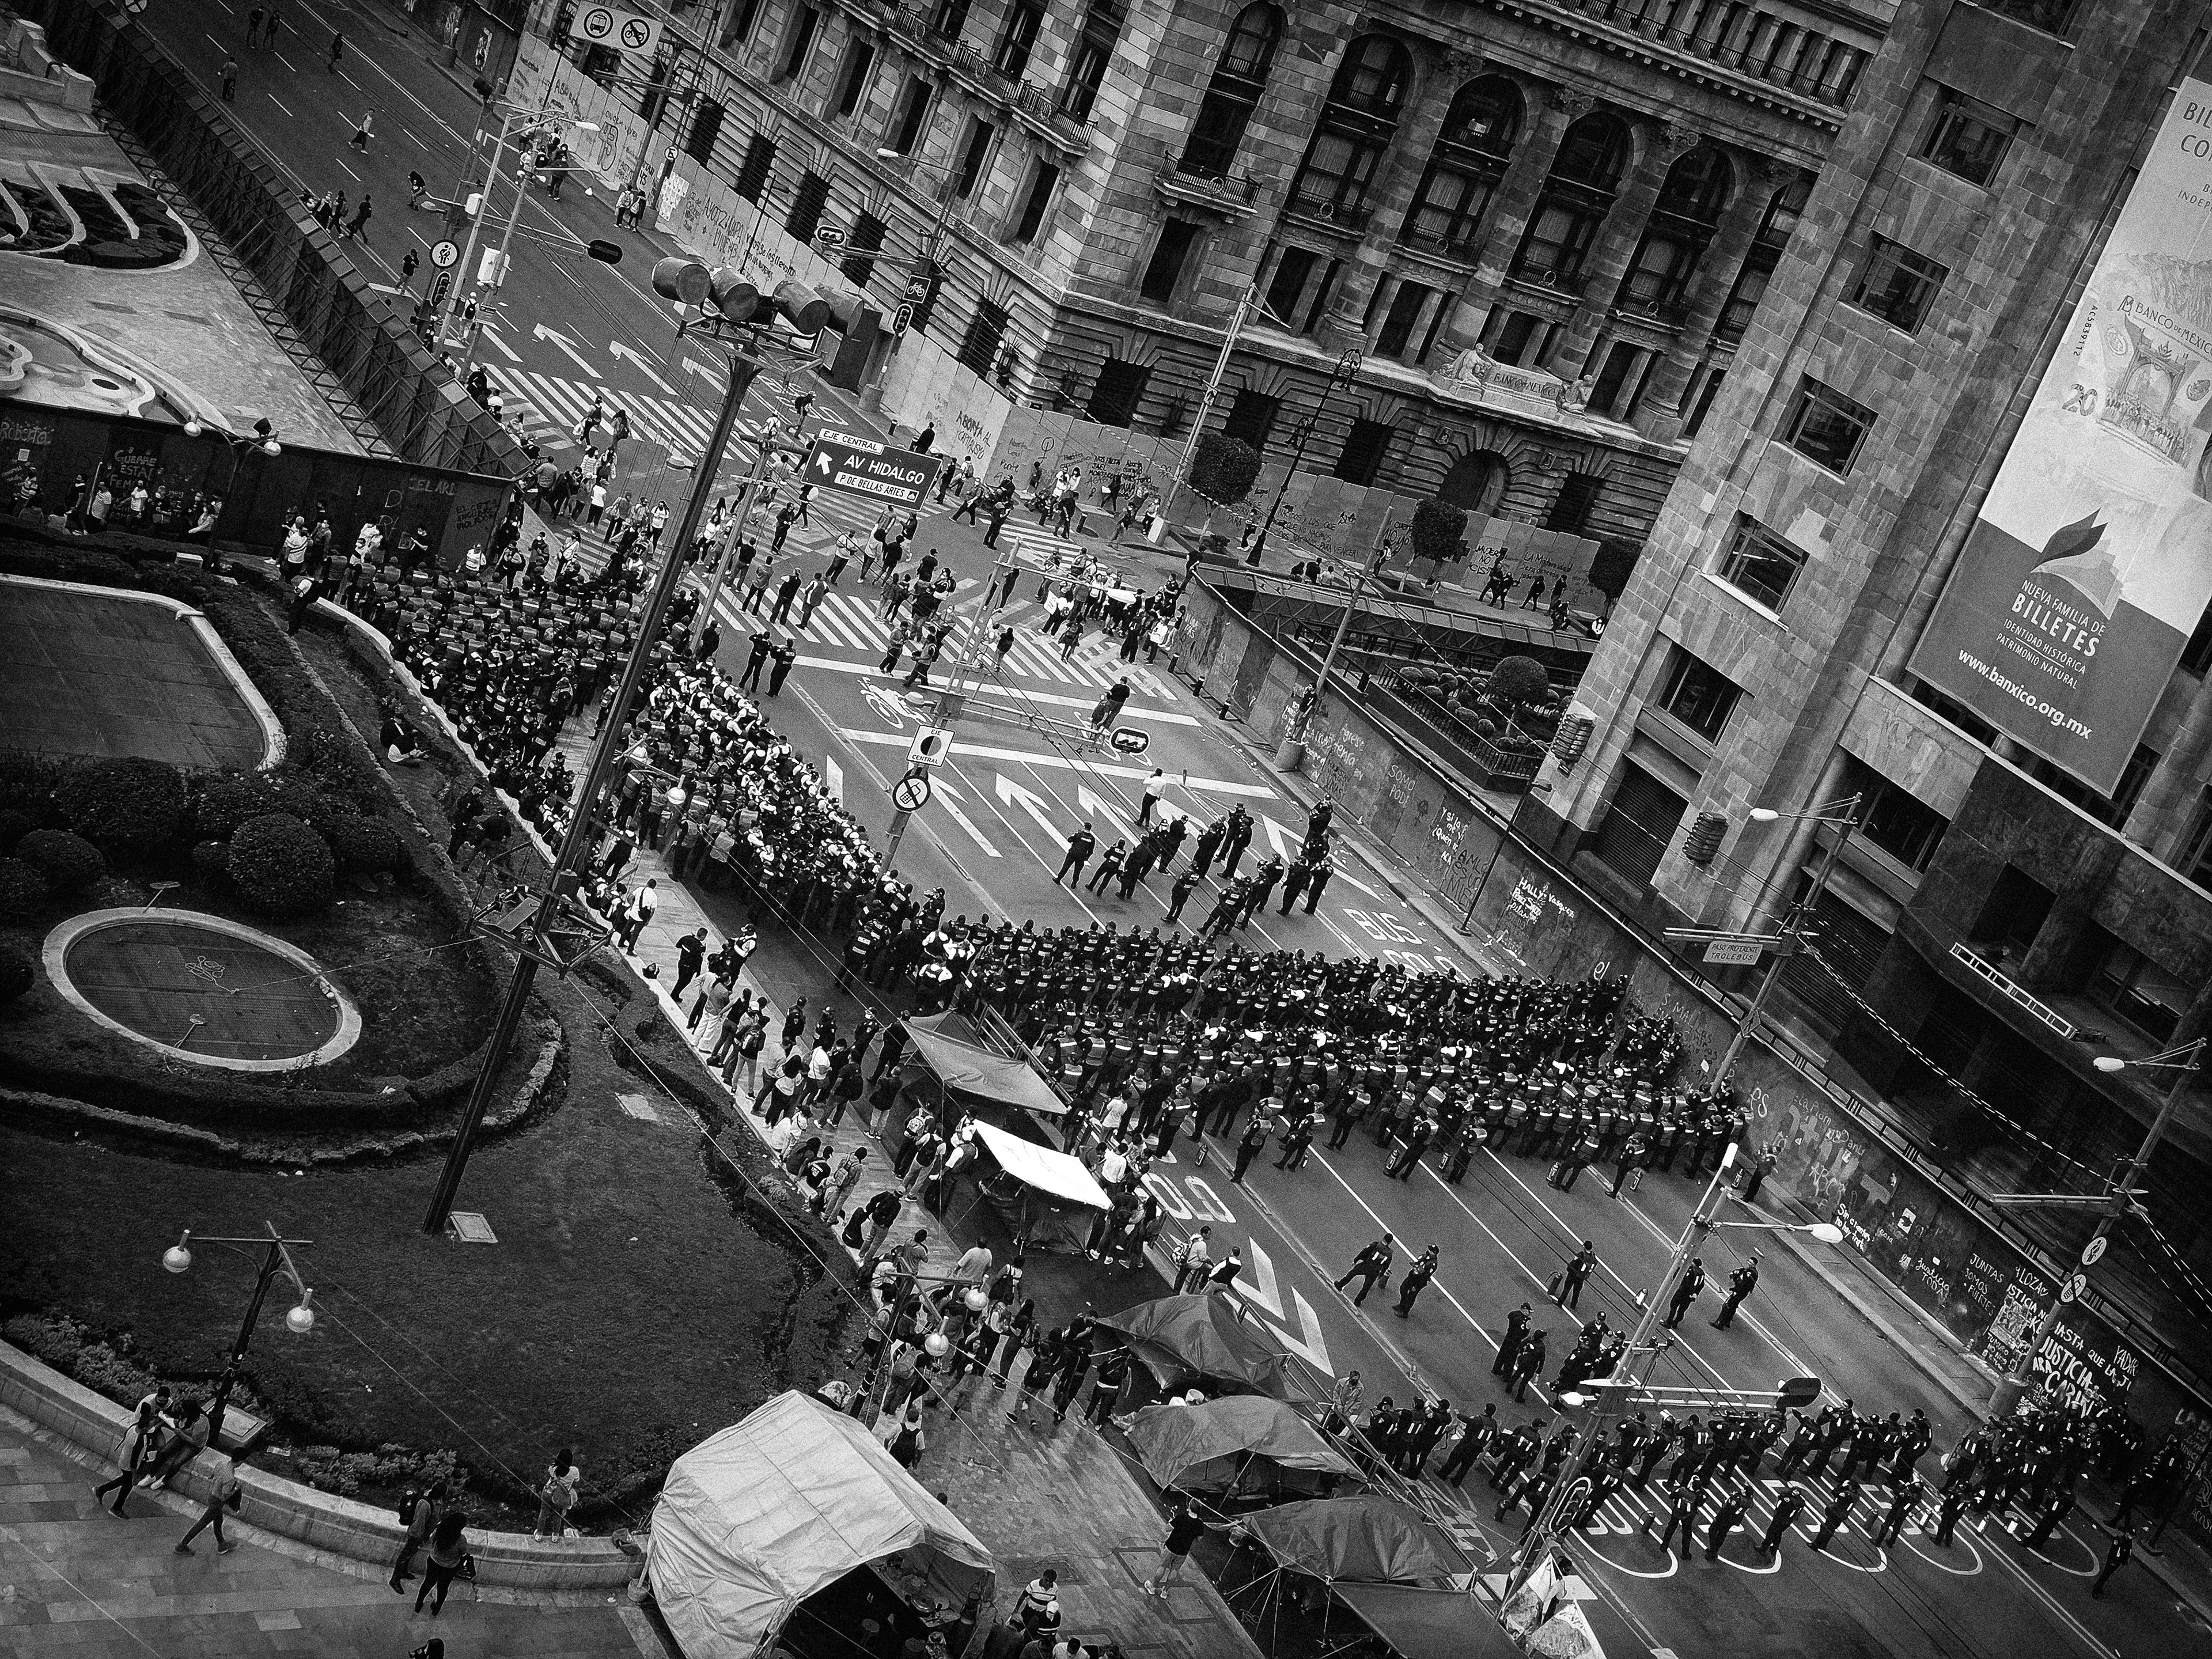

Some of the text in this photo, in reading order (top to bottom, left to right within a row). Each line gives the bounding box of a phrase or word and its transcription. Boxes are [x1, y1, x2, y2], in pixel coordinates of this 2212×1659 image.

[2180, 134, 2212, 162] CO
[2178, 189, 2212, 212] INDEP
[2135, 302, 2173, 329] BANCO
[823, 431, 877, 451] EJE CENTRAL
[843, 454, 925, 484] AV HIDALGO
[839, 475, 906, 497] P DE BELLAS ARTES
[1479, 555, 1491, 565] NO
[2021, 579, 2107, 637] NUEVA FAMILIA DE
[2011, 592, 2100, 657] BILLETES
[2003, 618, 2086, 675] IDENTIDAD HISTÓRICA
[1996, 632, 2078, 690] PATRIMONIO NATURAL
[1958, 649, 2093, 740] www.banxico.org.mx
[912, 754, 938, 764] CENTRAL
[1342, 908, 1423, 944] BUS
[1711, 952, 1753, 961] TROLEBUS
[1727, 945, 1760, 953] PREFERENTE
[1837, 1203, 1850, 1220] Sin
[1964, 1267, 1988, 1295] SOMOS
[1969, 1253, 2005, 1283] JUNTAS
[2038, 1335, 2093, 1390] JUSTICIA
[2087, 1349, 2105, 1368] QUE
